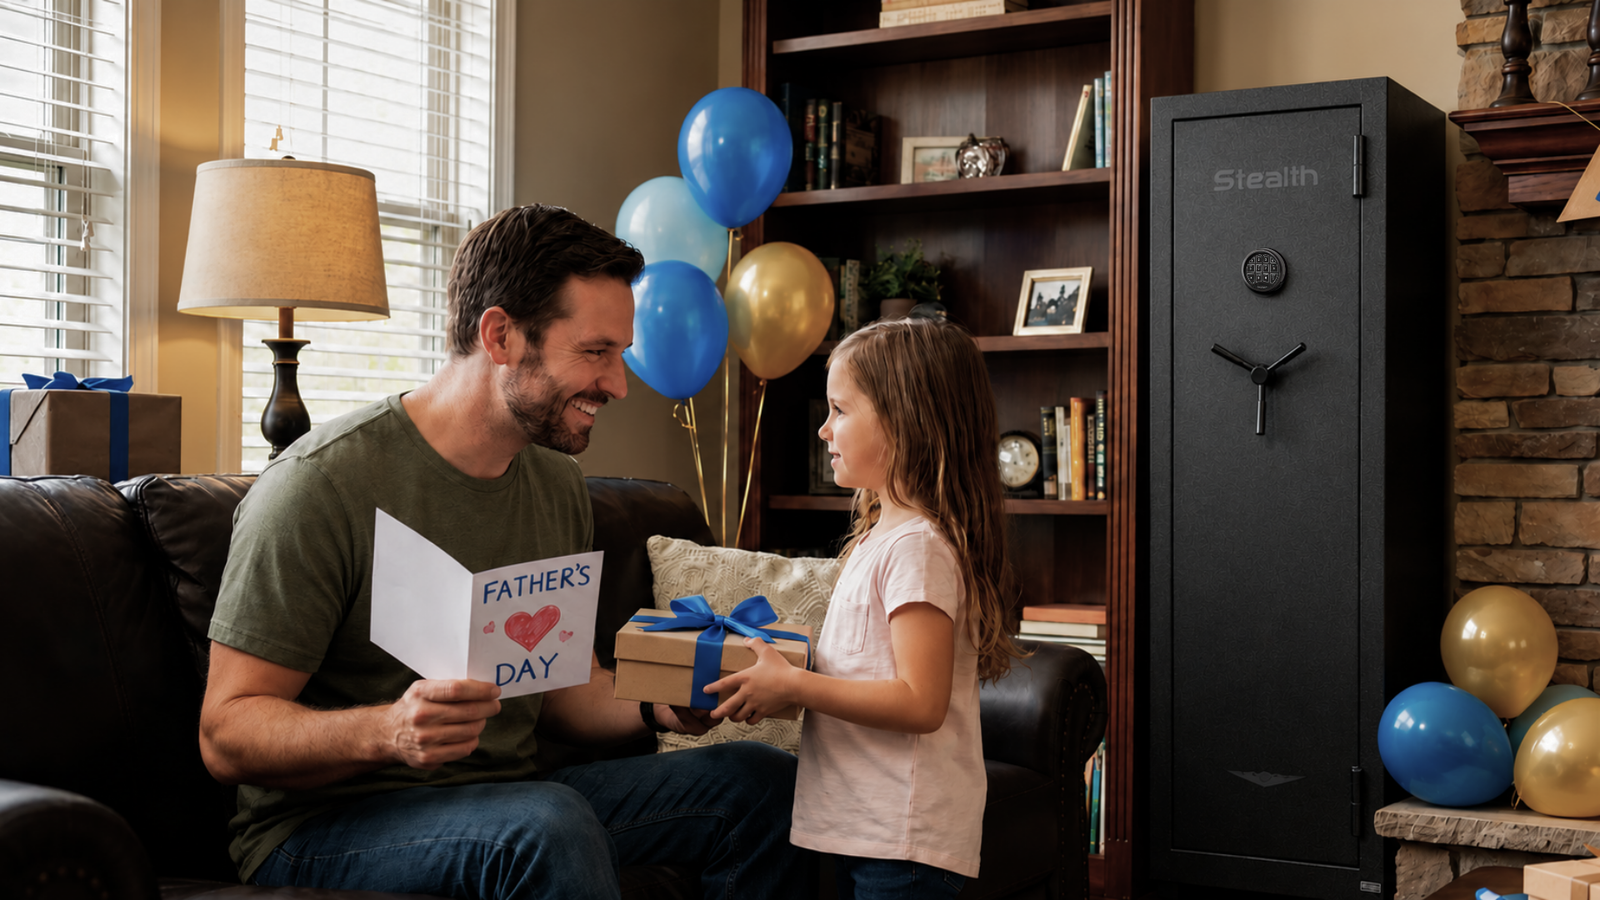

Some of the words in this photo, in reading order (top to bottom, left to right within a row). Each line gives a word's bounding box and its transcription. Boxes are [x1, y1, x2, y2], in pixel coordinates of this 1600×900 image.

[1213, 165, 1319, 192] Stealth
[483, 563, 591, 605] FATHER'S
[495, 652, 559, 687] DAY
